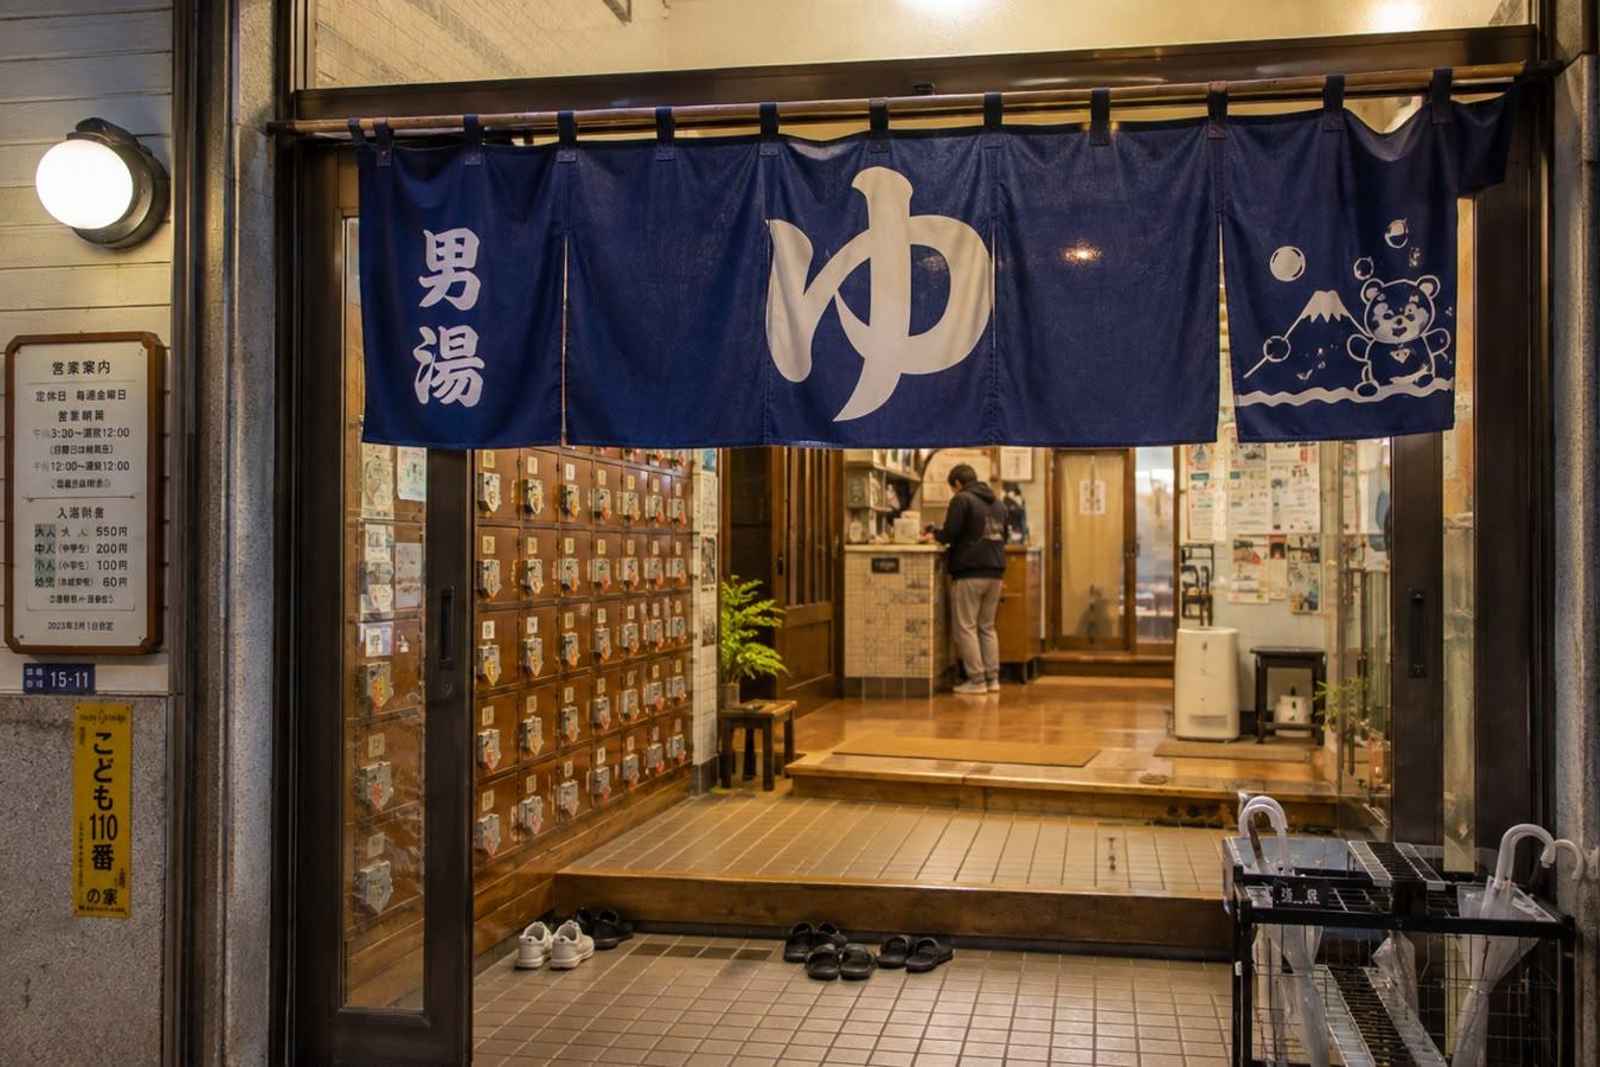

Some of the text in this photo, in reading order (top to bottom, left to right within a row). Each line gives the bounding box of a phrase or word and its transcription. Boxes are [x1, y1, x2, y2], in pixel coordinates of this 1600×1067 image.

[413, 227, 485, 408] 男湯
[765, 166, 993, 422] ゆ
[51, 671, 89, 688] 15-11
